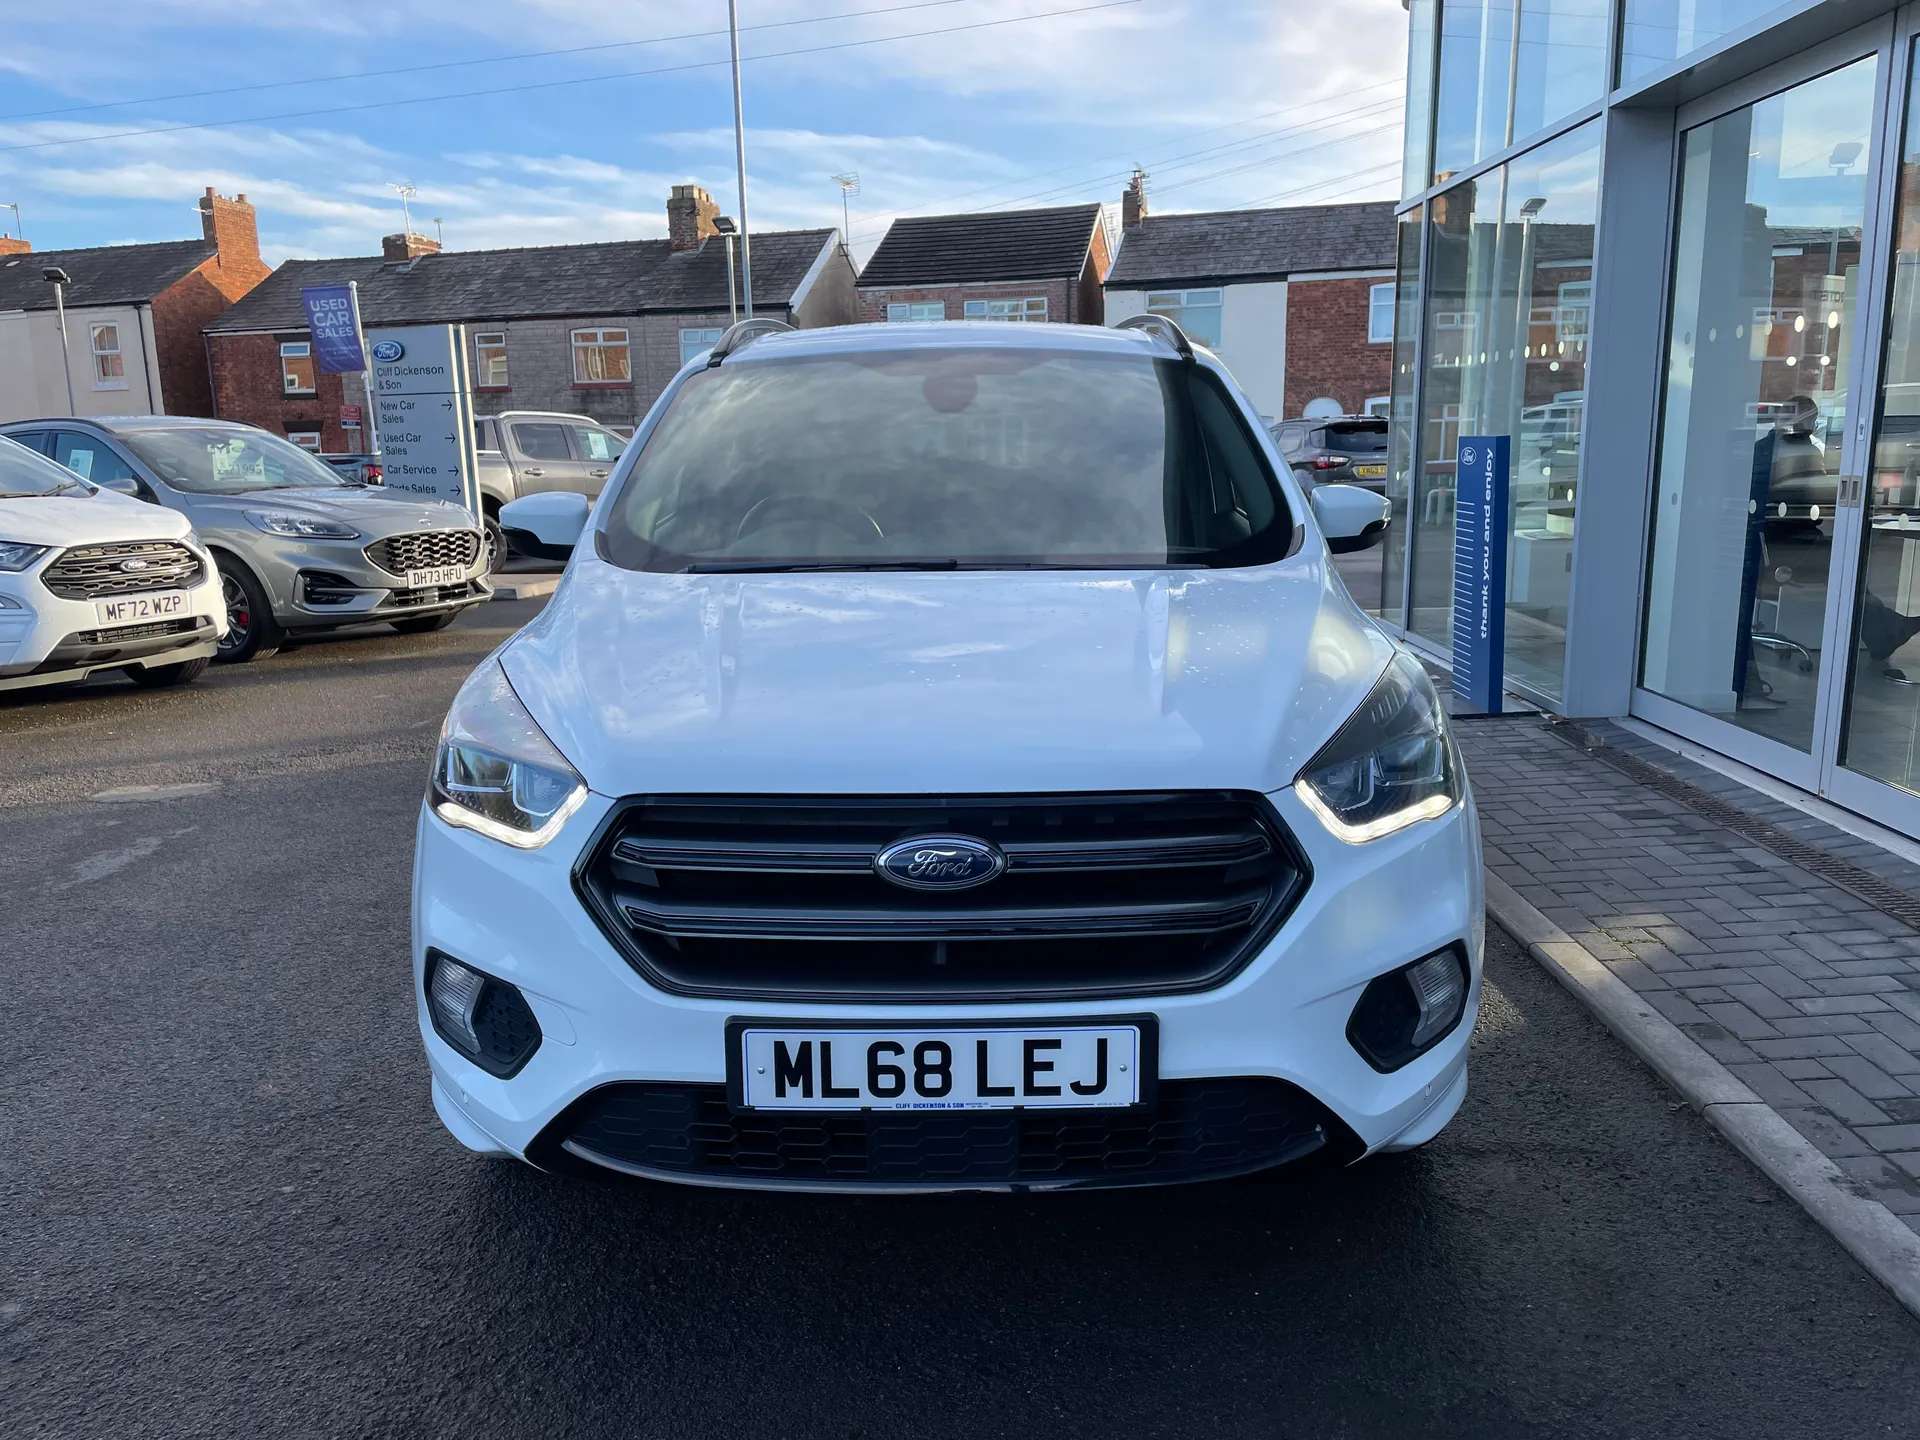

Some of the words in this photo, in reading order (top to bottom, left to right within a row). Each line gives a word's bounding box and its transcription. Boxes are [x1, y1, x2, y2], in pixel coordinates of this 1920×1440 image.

[310, 298, 348, 312] USED
[313, 311, 351, 327] CAR
[316, 326, 355, 339] SALES
[375, 342, 399, 360] Ford
[377, 366, 394, 377] Cliff
[394, 365, 444, 376] Dickenson
[378, 380, 385, 390] &
[385, 380, 402, 390] Son
[380, 401, 398, 411] New
[399, 400, 416, 411] Car
[382, 414, 405, 424] Sales
[383, 433, 405, 443] Used
[405, 433, 422, 443] Car
[385, 446, 408, 456] Sales
[387, 465, 402, 475] Car
[402, 464, 437, 475] Service
[1484, 447, 1494, 503] enjoy
[411, 484, 437, 494] Sales
[1482, 504, 1491, 542] and
[1482, 545, 1491, 582] you
[413, 570, 440, 585] DH73
[443, 568, 462, 582] HFU
[106, 600, 149, 620] MF72
[153, 596, 182, 614] WZP
[1480, 585, 1489, 639] thank
[908, 850, 973, 877] Ford
[773, 1039, 954, 1098] ML68
[975, 1038, 1109, 1098] LEJ
